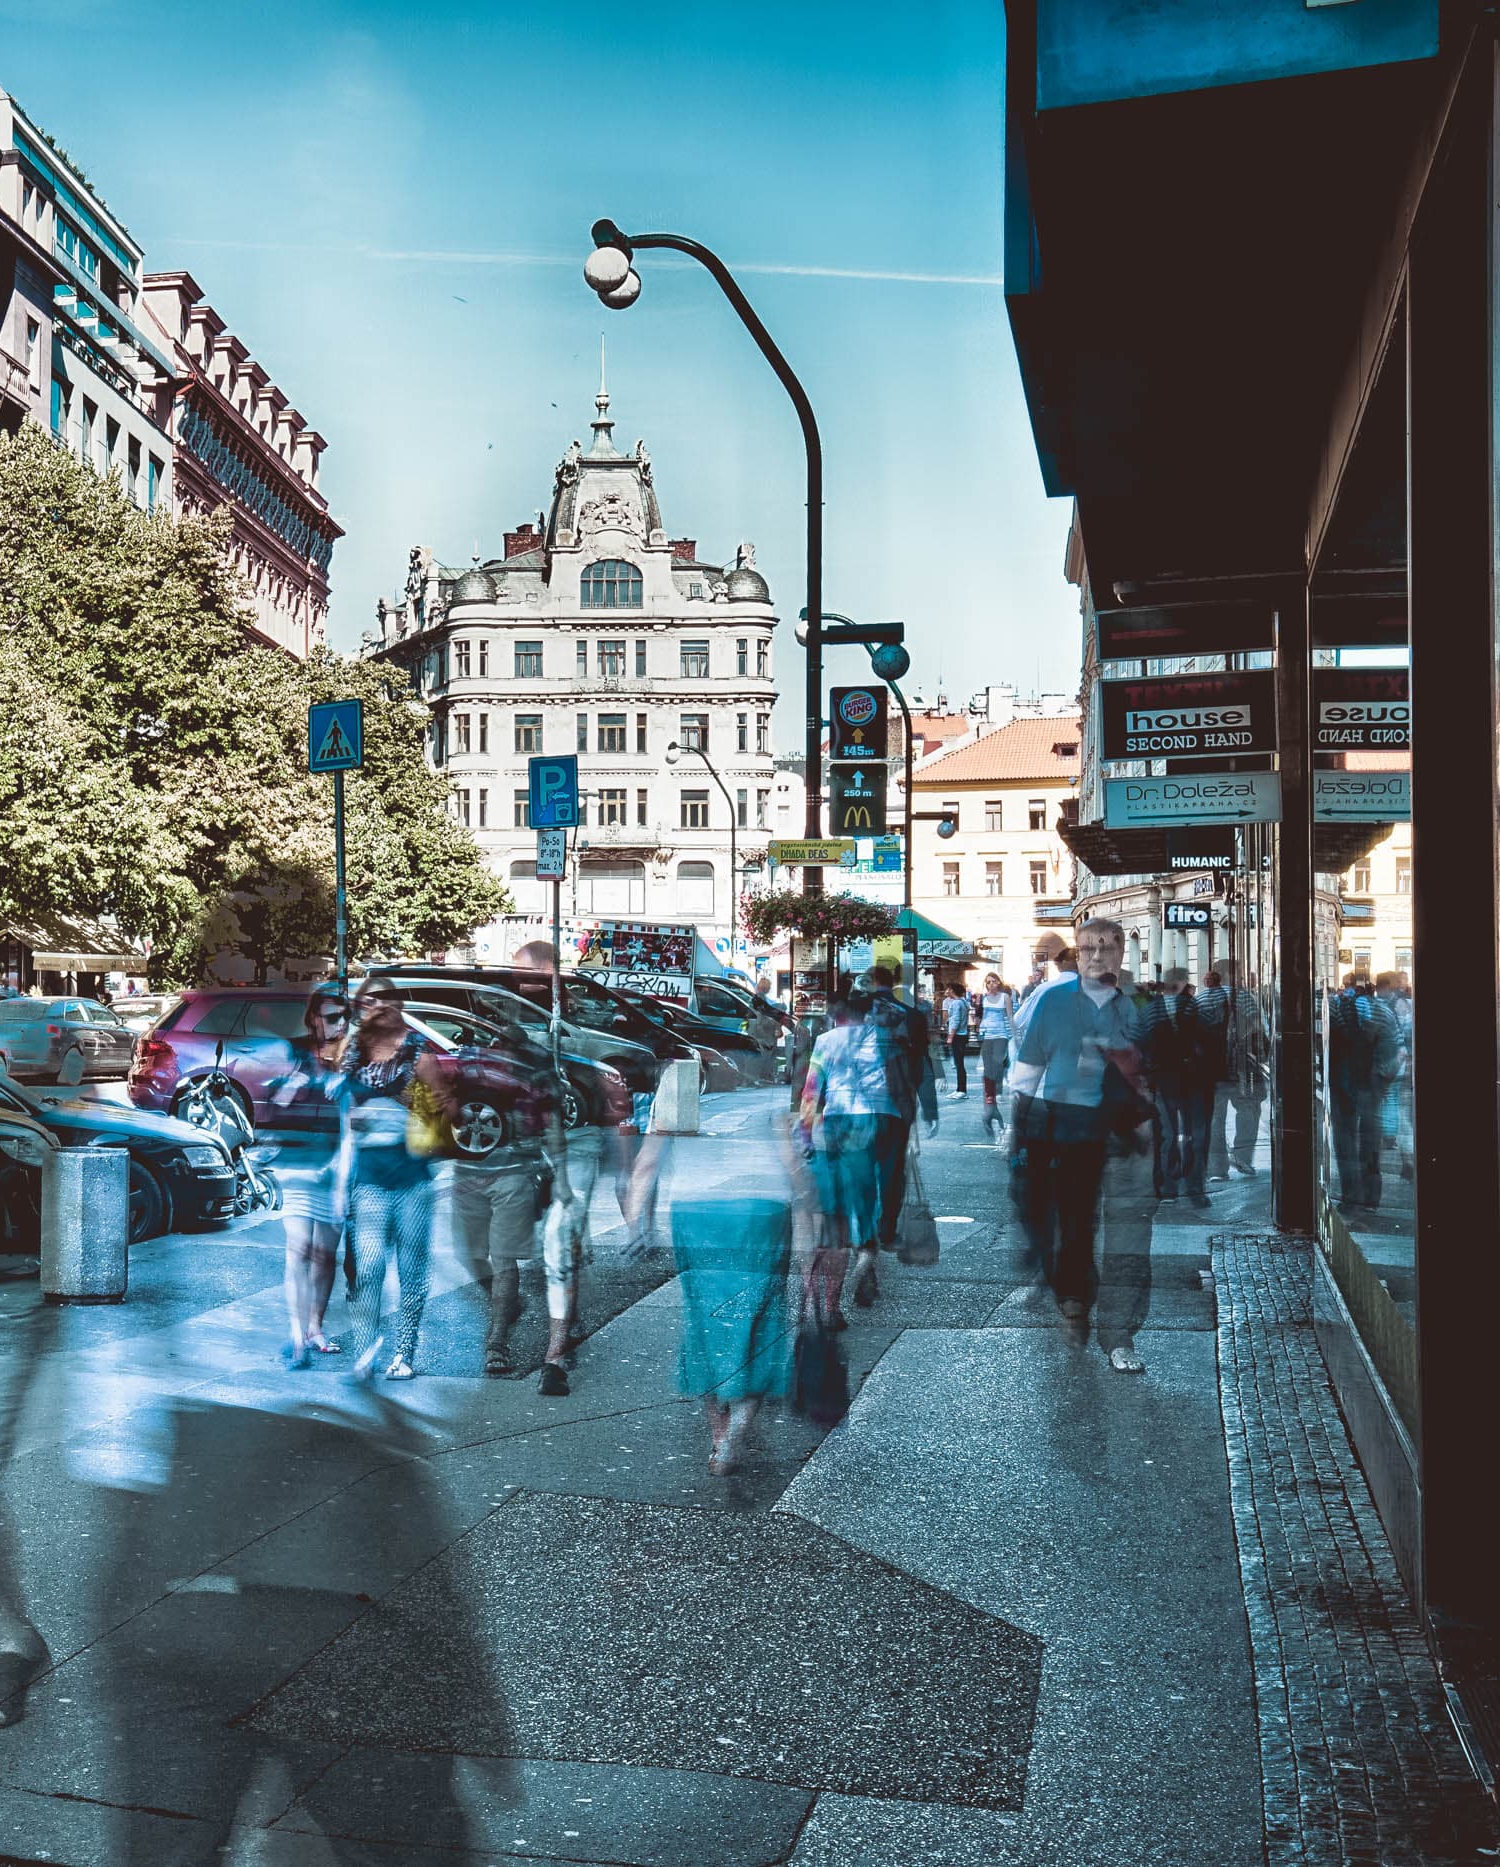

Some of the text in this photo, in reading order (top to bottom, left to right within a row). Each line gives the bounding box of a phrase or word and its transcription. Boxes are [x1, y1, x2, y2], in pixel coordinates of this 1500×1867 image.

[844, 697, 872, 709] BURGER
[845, 702, 873, 717] KING
[1132, 711, 1244, 730] house
[1126, 732, 1253, 751] SECOND HAND
[843, 789, 861, 797] 250
[1171, 857, 1231, 868] HUMANIC
[1167, 905, 1208, 923] firo
